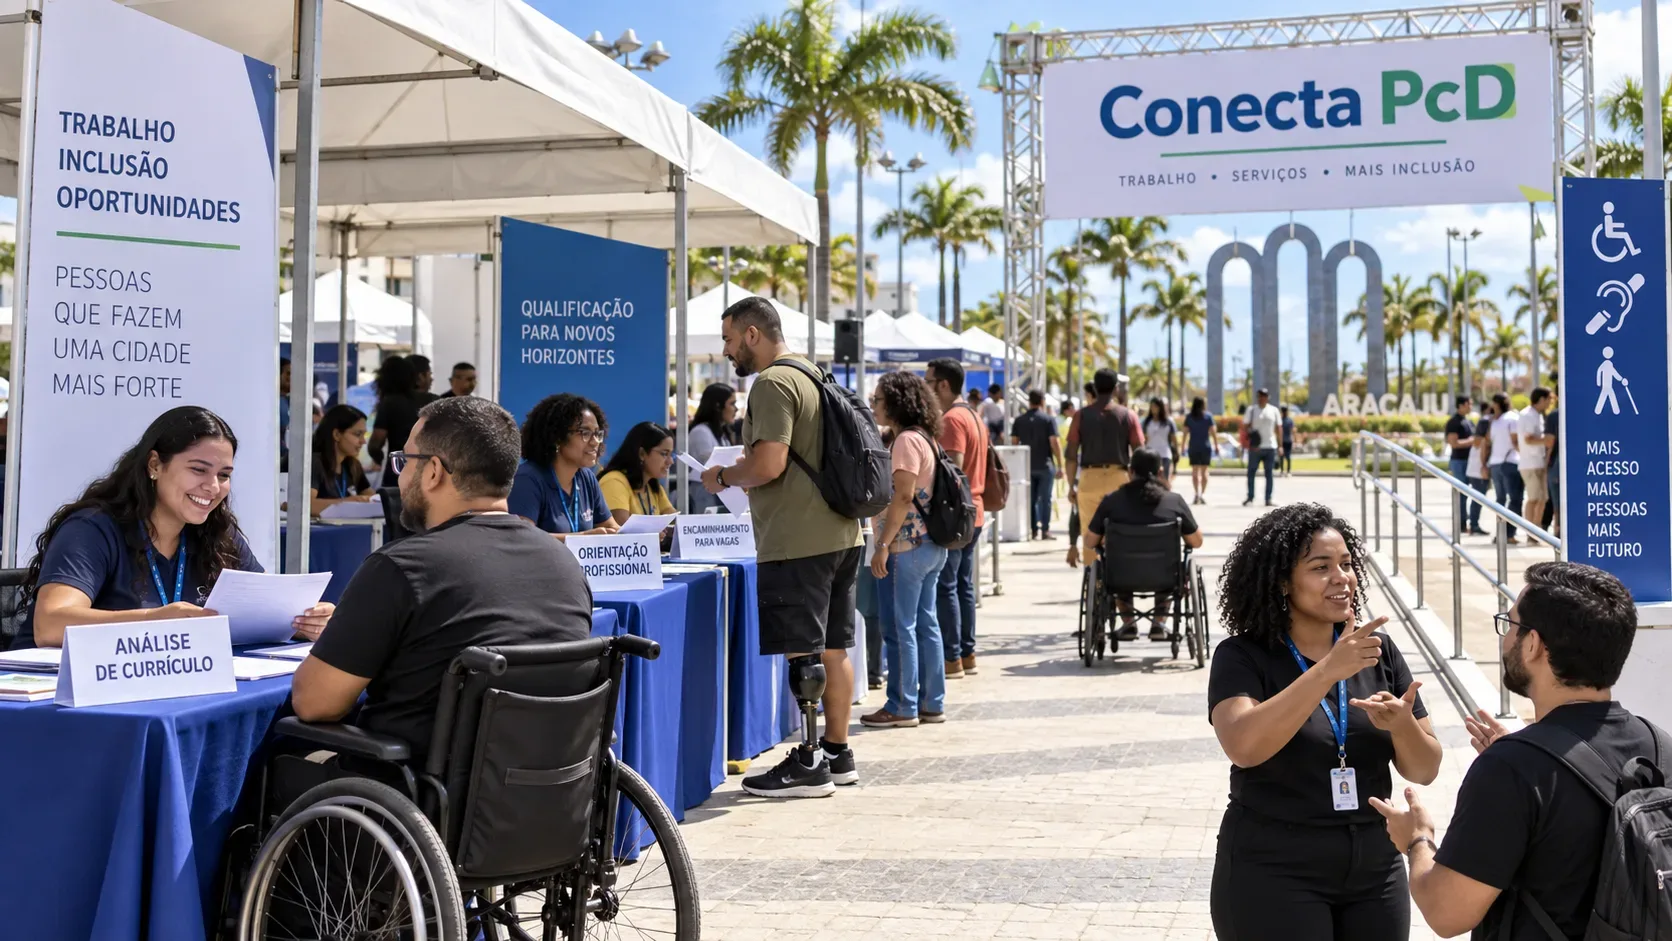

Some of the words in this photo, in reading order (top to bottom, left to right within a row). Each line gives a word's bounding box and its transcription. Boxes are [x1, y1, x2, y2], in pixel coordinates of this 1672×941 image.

[1100, 80, 1361, 139] Conecta
[1381, 63, 1515, 125] PcD
[59, 111, 175, 143] TRABALHO
[59, 148, 169, 179] INCLUSÃO
[1119, 172, 1197, 187] TRABALHO
[1232, 167, 1308, 183] SERVIÇOS
[1345, 163, 1384, 177] MAIS
[1392, 158, 1476, 175] INCLUSÃO
[57, 186, 241, 223] OPORTUNIDADES
[56, 266, 152, 293] PESSOAS
[54, 301, 101, 326] QUE
[111, 304, 182, 329] FAZEM
[521, 298, 634, 321] QUALIFICAÇÃO
[521, 324, 560, 340] PARA
[564, 325, 616, 342] NOVOS
[54, 337, 104, 360] UMA
[112, 340, 191, 364] CIDADE
[521, 348, 615, 365] HORIZONTES
[53, 373, 105, 396] MAIS
[114, 376, 182, 398] FORTE
[1322, 392, 1449, 417] ARACAJU
[1586, 441, 1620, 455] MAIS
[1586, 461, 1640, 475] ACESSO
[1587, 482, 1620, 496] MAIS
[1587, 502, 1647, 517] PESSOAS
[683, 524, 750, 535] ENCAMINHAMENTO
[1588, 523, 1621, 537] MAIS
[578, 542, 648, 561] ORIENTAÇÃO
[695, 537, 715, 547] PARA
[715, 536, 740, 546] VAGAS
[1588, 542, 1642, 558] FUTURO
[115, 632, 191, 655] ANÁLISE
[96, 664, 118, 681] DE
[122, 655, 213, 679] CURRÍCULO
